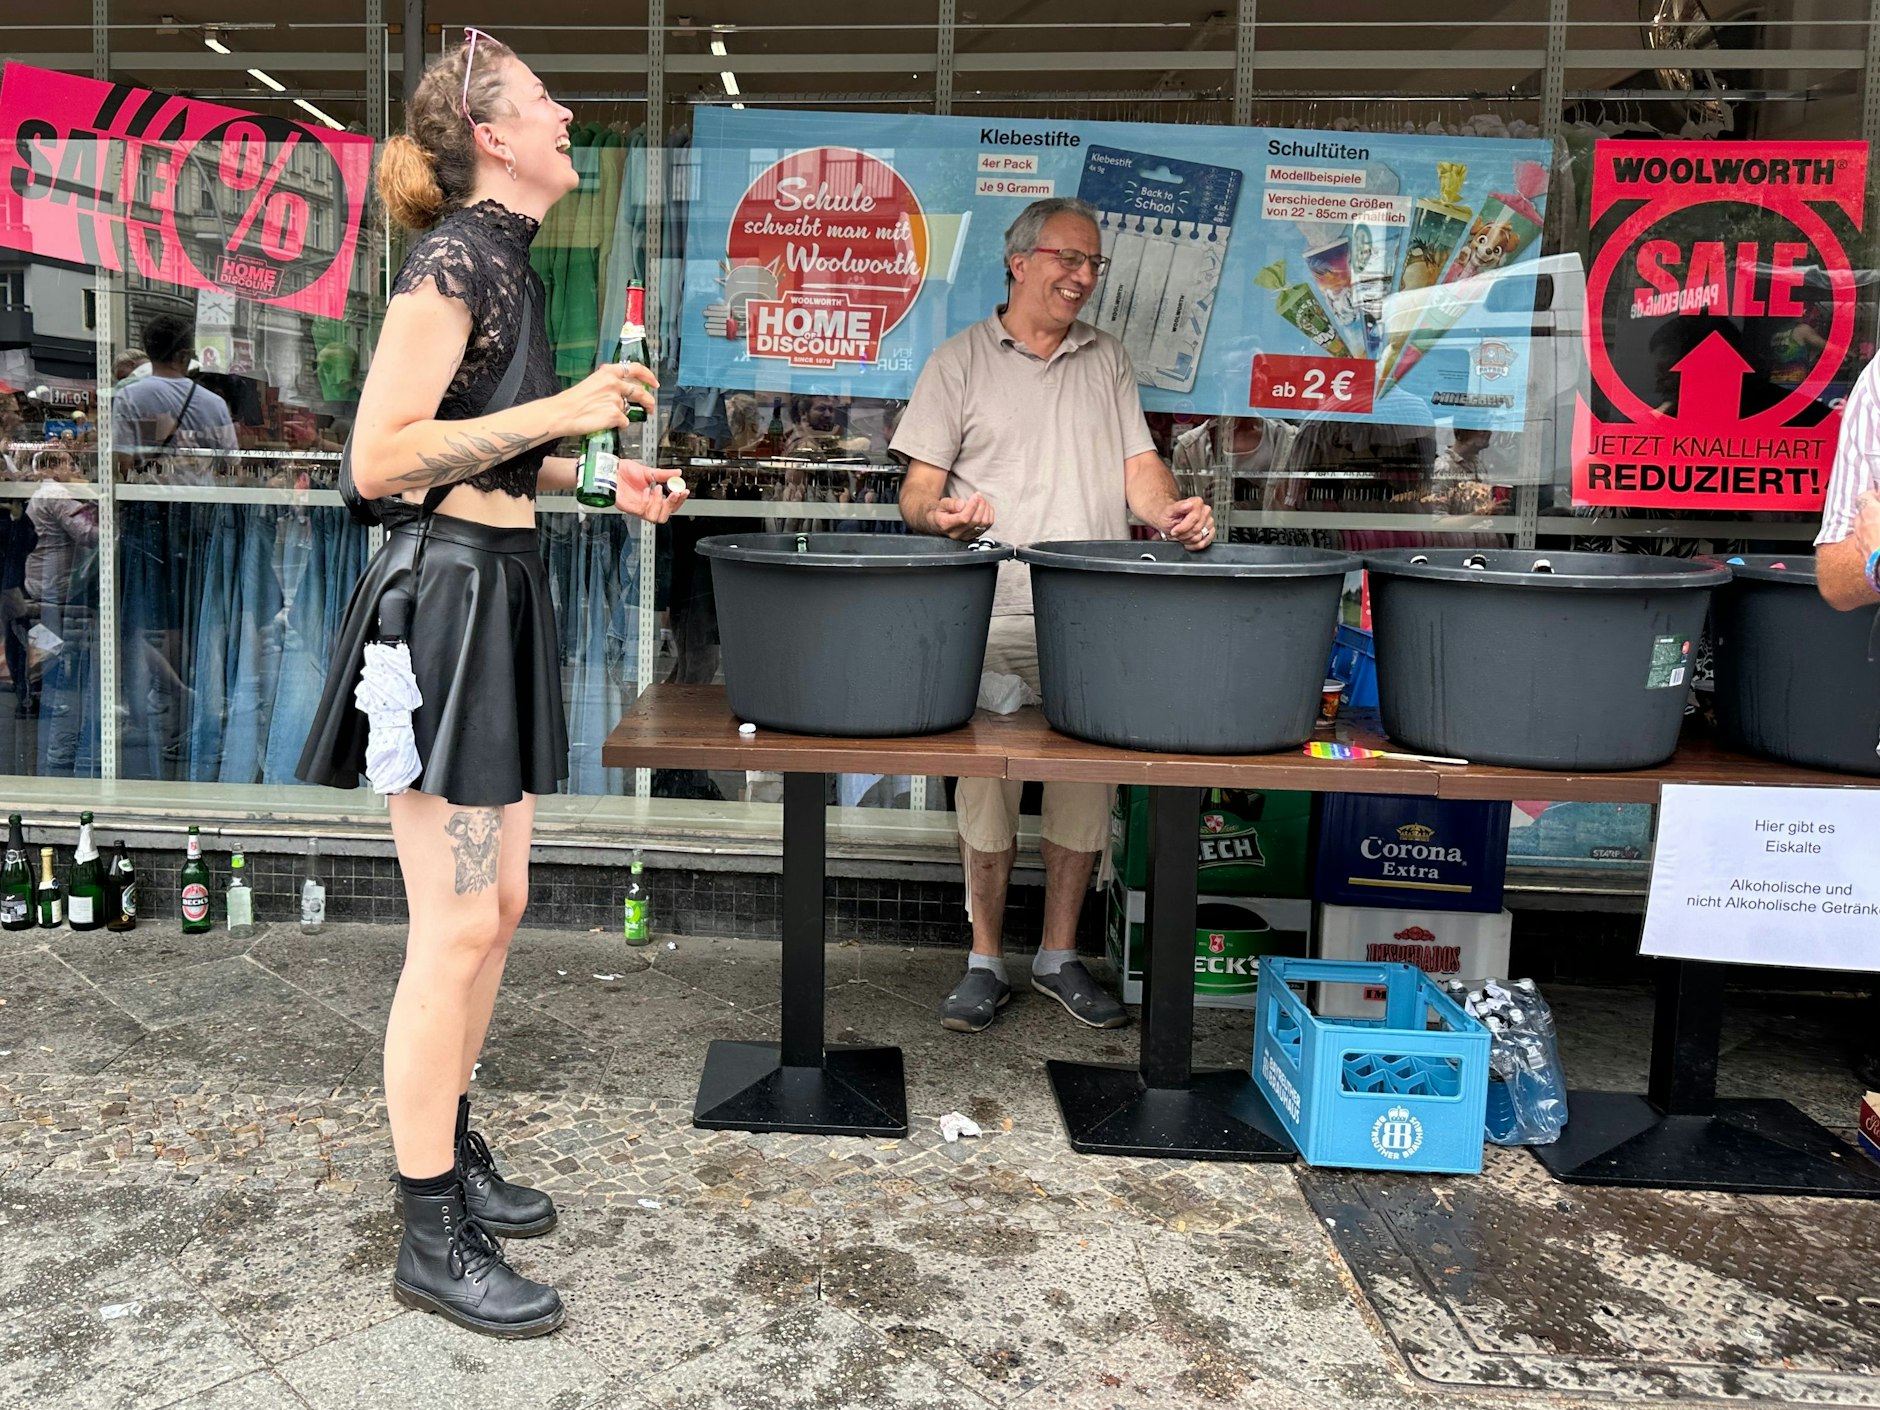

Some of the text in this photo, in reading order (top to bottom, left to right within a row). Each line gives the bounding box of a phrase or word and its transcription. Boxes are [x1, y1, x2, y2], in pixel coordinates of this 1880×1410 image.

[980, 128, 1080, 147] Klebestifte
[1268, 140, 1370, 160] Schultüten
[982, 158, 1033, 170] 4er Pack
[1091, 153, 1132, 168] Klebestift
[1270, 169, 1362, 184] Modellbeispiele
[774, 176, 877, 213] Schule
[980, 182, 1050, 194] Je 9 Gramm
[1141, 186, 1174, 200] Back to
[1134, 197, 1175, 215] School
[1268, 193, 1393, 210] Verschiedene Größen
[1267, 208, 1288, 217] von
[1291, 207, 1305, 218] 22
[1316, 208, 1348, 220] 85cm
[744, 212, 912, 241] schreibt man mit
[786, 241, 922, 277] Woolworth
[221, 259, 277, 284] HOME
[1634, 239, 1809, 318] SALE
[220, 273, 275, 293] DISCOUNT
[790, 295, 843, 307] WOOLWORTH
[758, 306, 872, 340] HOME
[757, 334, 870, 358] DISCOUNT
[793, 356, 814, 364] SINCE
[1272, 381, 1297, 398] ab
[1588, 435, 1826, 460] JETZT KNALLHART
[1588, 463, 1821, 495] REDUZIERT!
[1755, 819, 1836, 836] Hier gibt es
[1360, 836, 1463, 863] Corona
[1765, 840, 1822, 854] Eiskalte
[1382, 861, 1440, 880] Extra
[1730, 878, 1853, 896] Alkoholische und
[1686, 895, 1722, 909] nicht
[1725, 897, 1817, 913] Alkoholische
[1194, 955, 1260, 976] ECK'S
[1371, 1115, 1400, 1160] BAYREUTHER
